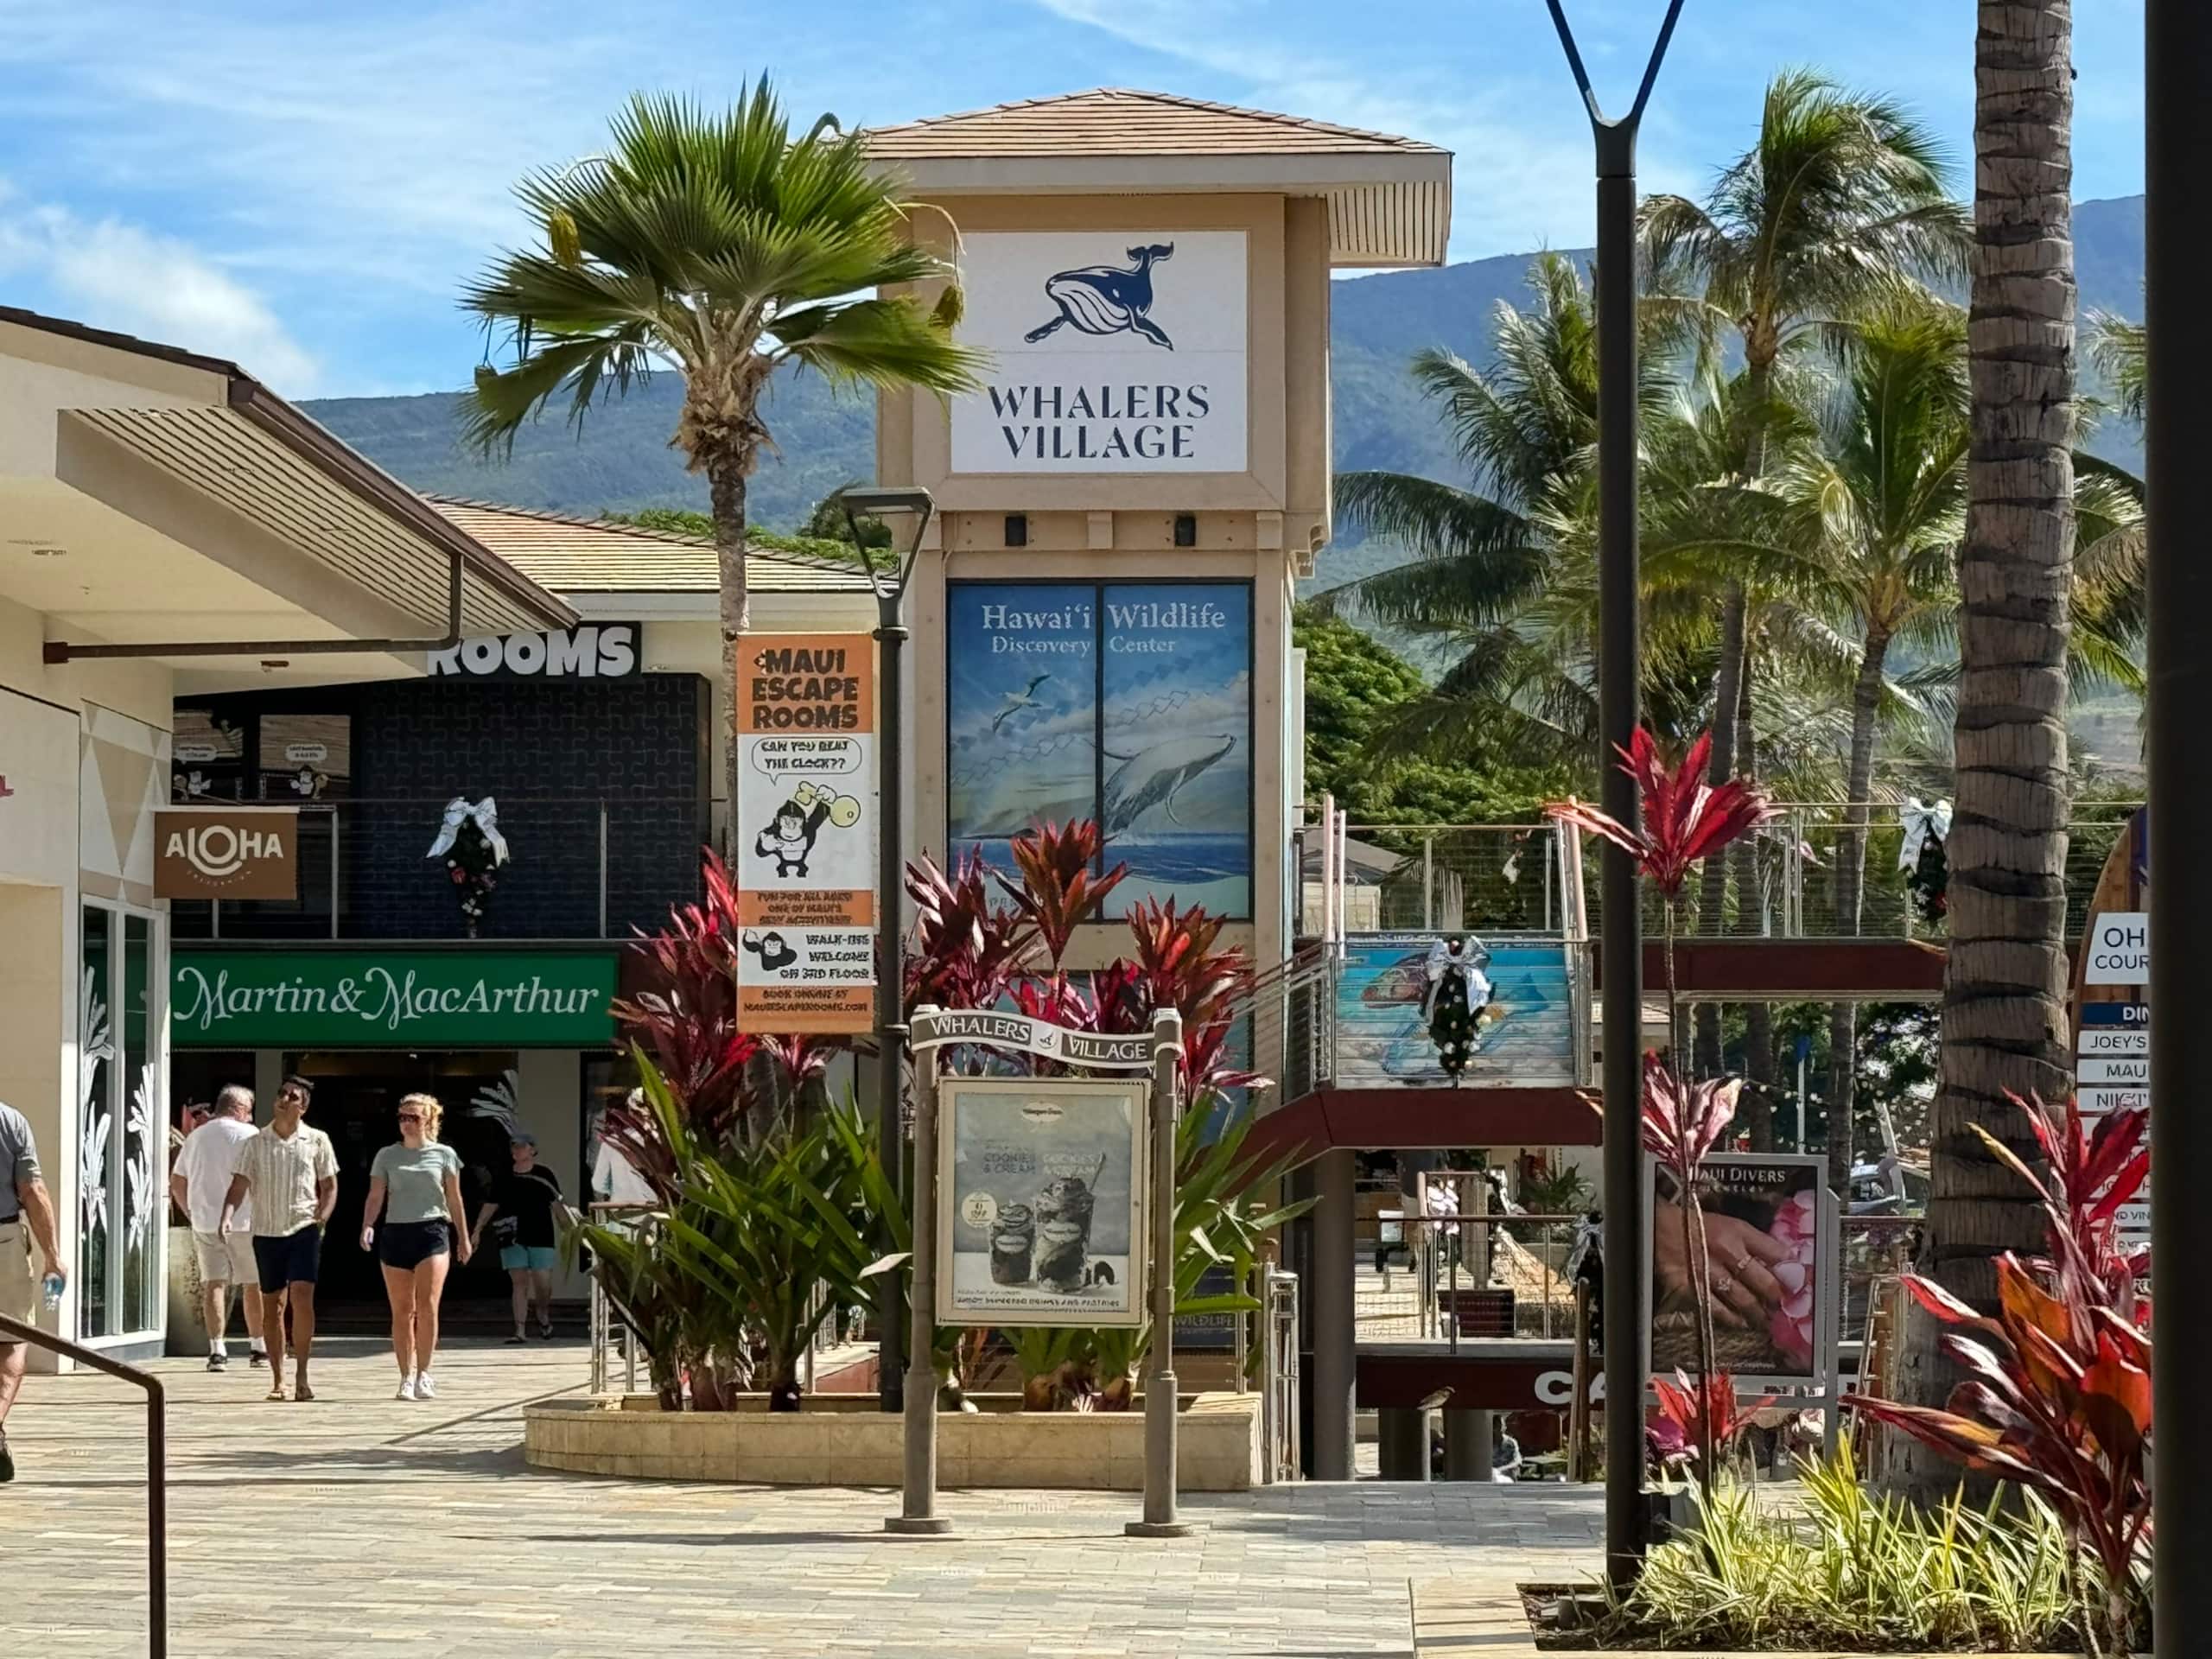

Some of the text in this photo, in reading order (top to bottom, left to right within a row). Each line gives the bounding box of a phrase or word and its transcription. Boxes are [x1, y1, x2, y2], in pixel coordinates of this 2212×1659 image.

[988, 385, 1210, 419] WHALERS
[1002, 424, 1194, 459] VILLAGE
[1108, 602, 1225, 629] Wildlife
[993, 635, 1175, 658] Discovery Center
[766, 648, 846, 674] MAUI
[752, 677, 859, 702] ESCAPE
[753, 704, 858, 728] ROOMS
[760, 741, 787, 752] CAN
[765, 758, 788, 769] THE
[164, 825, 283, 875] ALOHA
[829, 969, 869, 979] FLOOR
[931, 1014, 1148, 1059] WHALERS VILLAGE
[2090, 1035, 2147, 1048] JOEY'S
[1730, 1167, 1786, 1183] DIVERS
